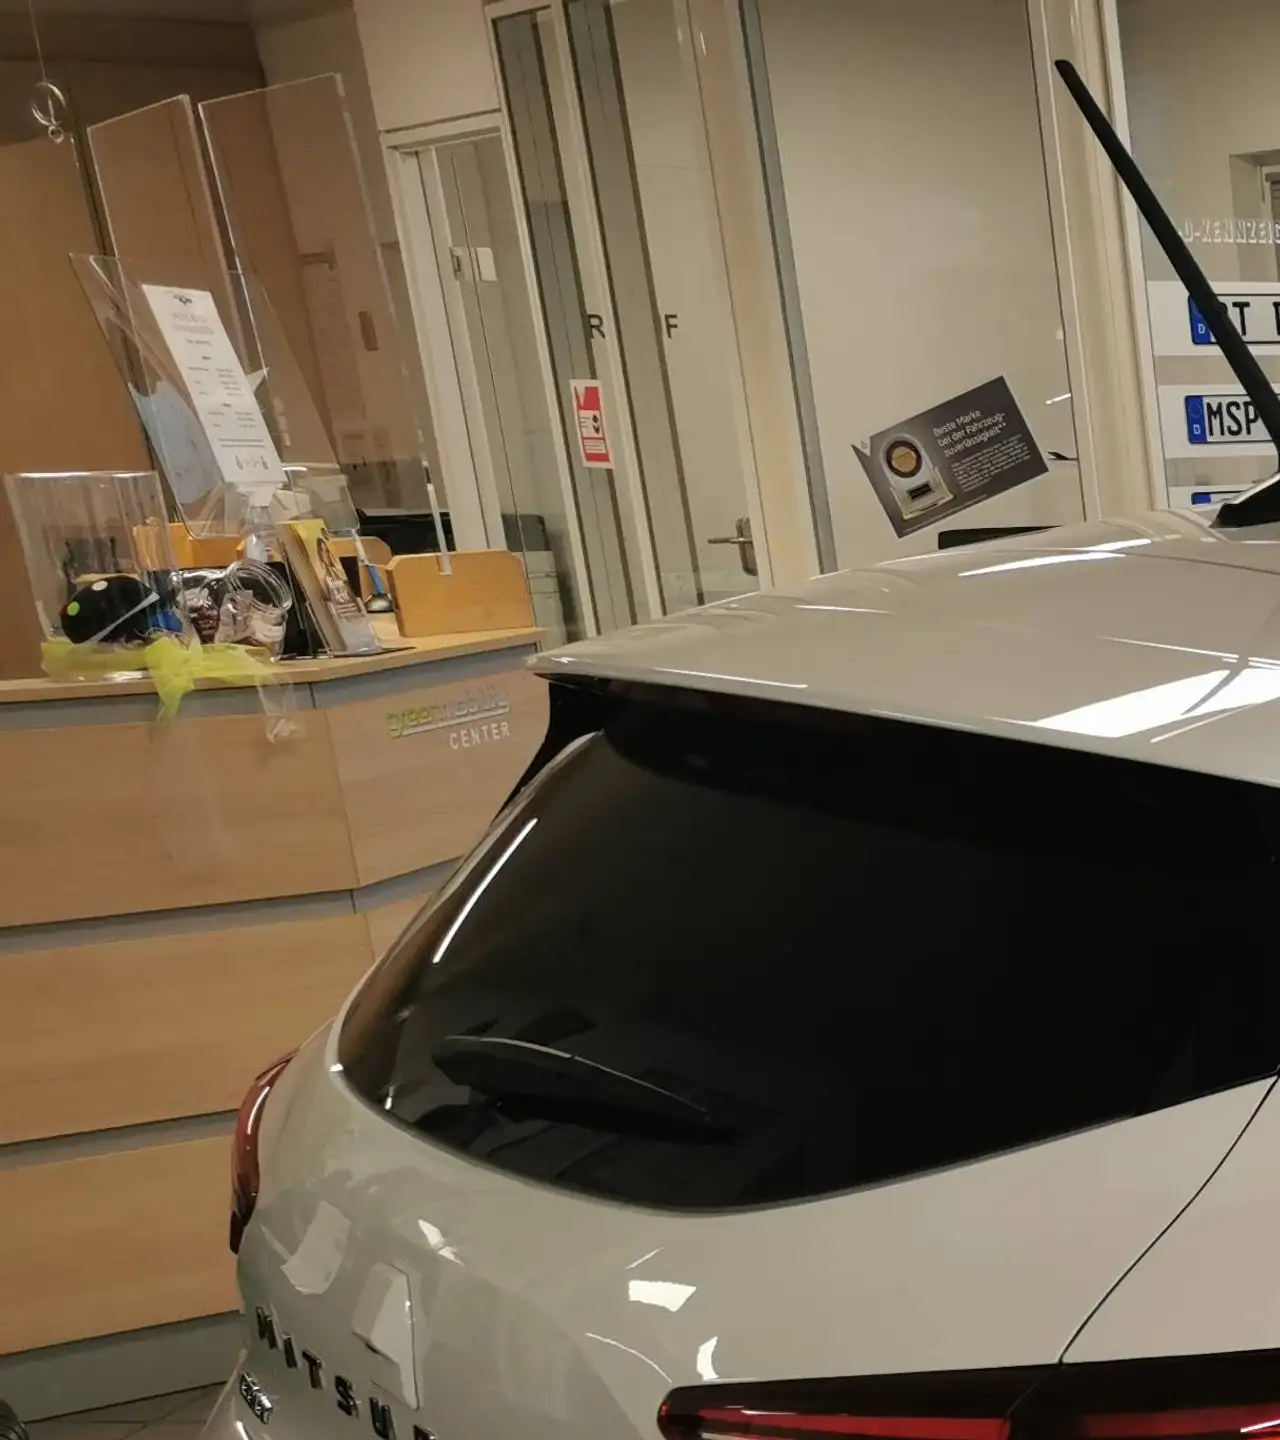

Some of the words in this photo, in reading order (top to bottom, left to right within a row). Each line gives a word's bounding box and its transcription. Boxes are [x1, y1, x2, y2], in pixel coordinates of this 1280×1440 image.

[585, 313, 606, 339] R
[664, 313, 678, 339] F
[955, 409, 982, 426] Marke
[1206, 400, 1260, 436] MSP
[449, 721, 511, 750] CENTER
